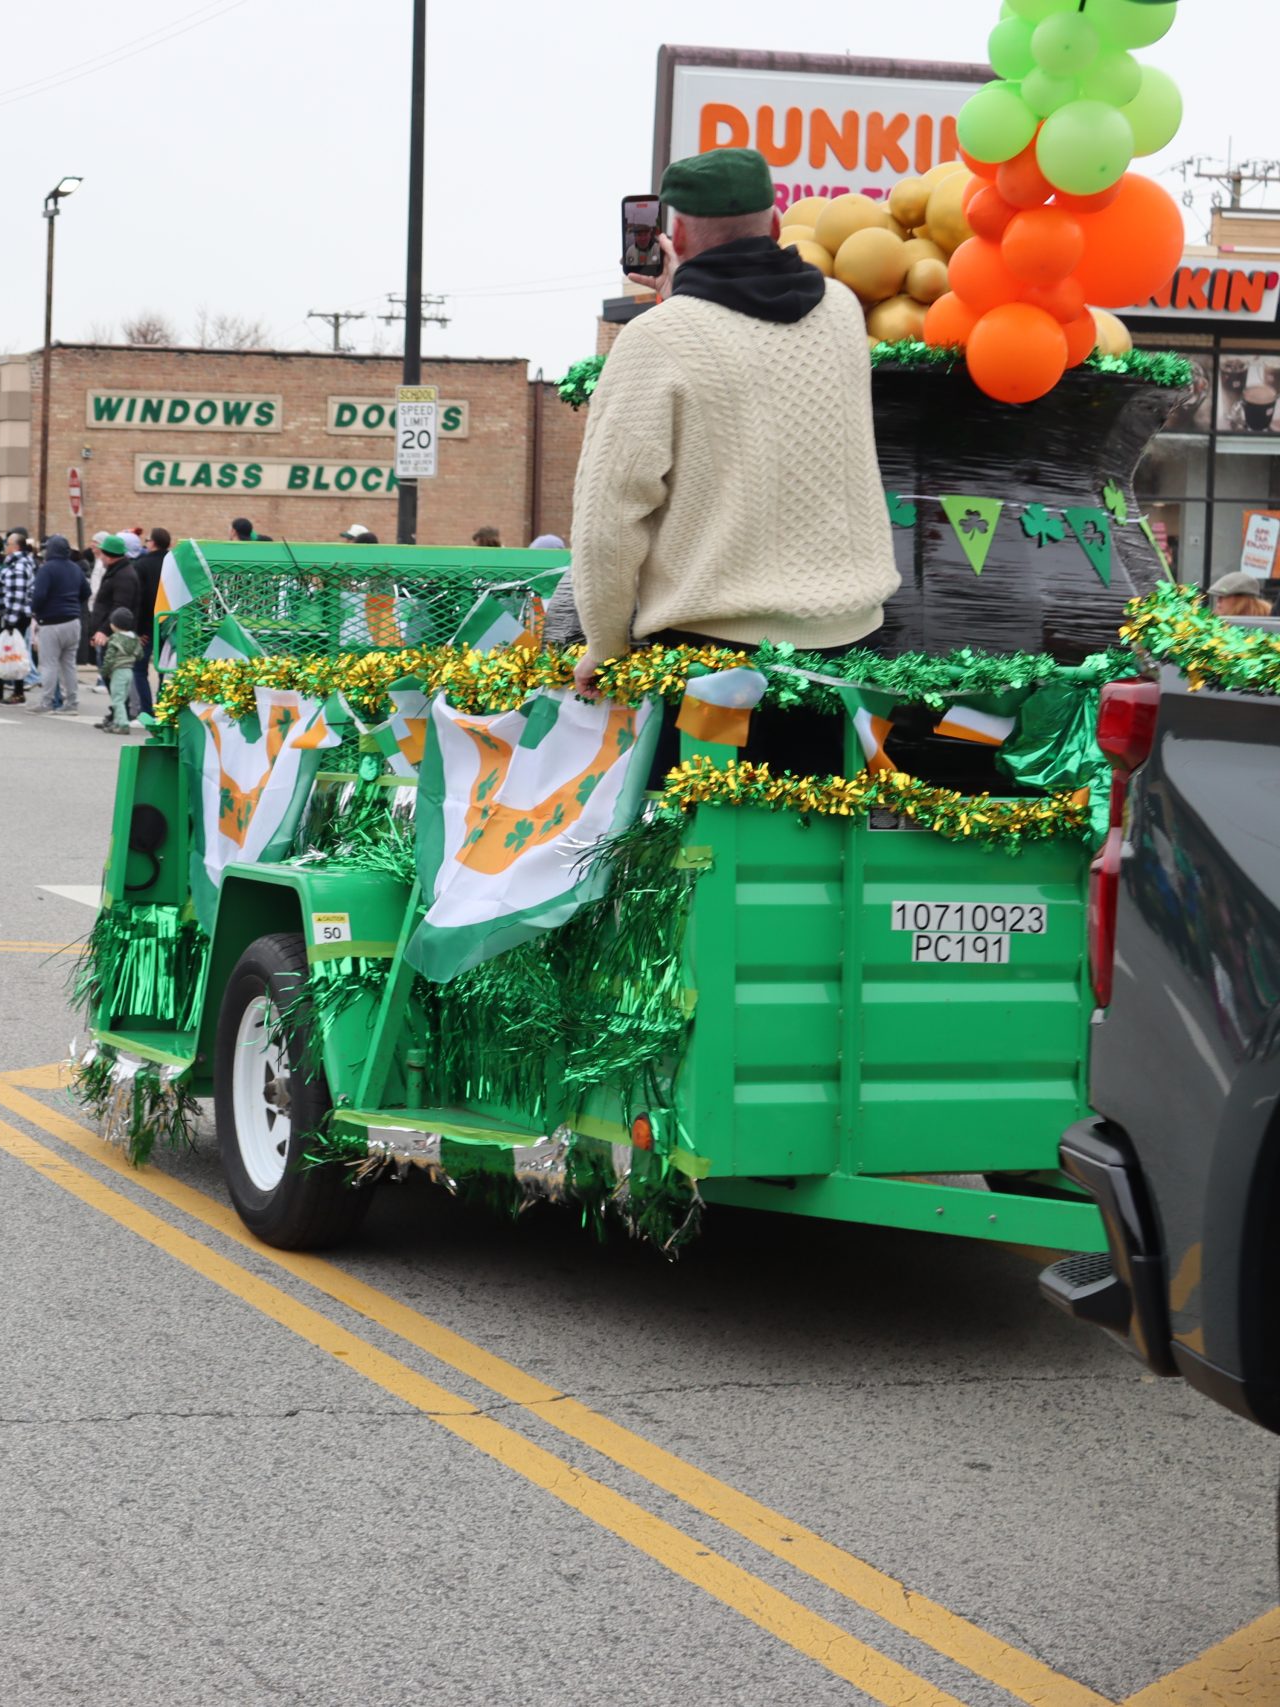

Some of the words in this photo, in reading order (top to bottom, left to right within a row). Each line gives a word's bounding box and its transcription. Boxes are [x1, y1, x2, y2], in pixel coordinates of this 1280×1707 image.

[400, 390, 433, 400] SCHOOL
[93, 397, 276, 427] WINDOWS
[334, 403, 463, 432] DOS
[400, 405, 433, 415] SPEED
[403, 417, 429, 427] LIMIT
[402, 430, 431, 449] 20
[143, 460, 263, 488] GLASS
[895, 903, 1044, 933] 10710923
[324, 927, 341, 939] 50
[915, 935, 1003, 962] PC191
